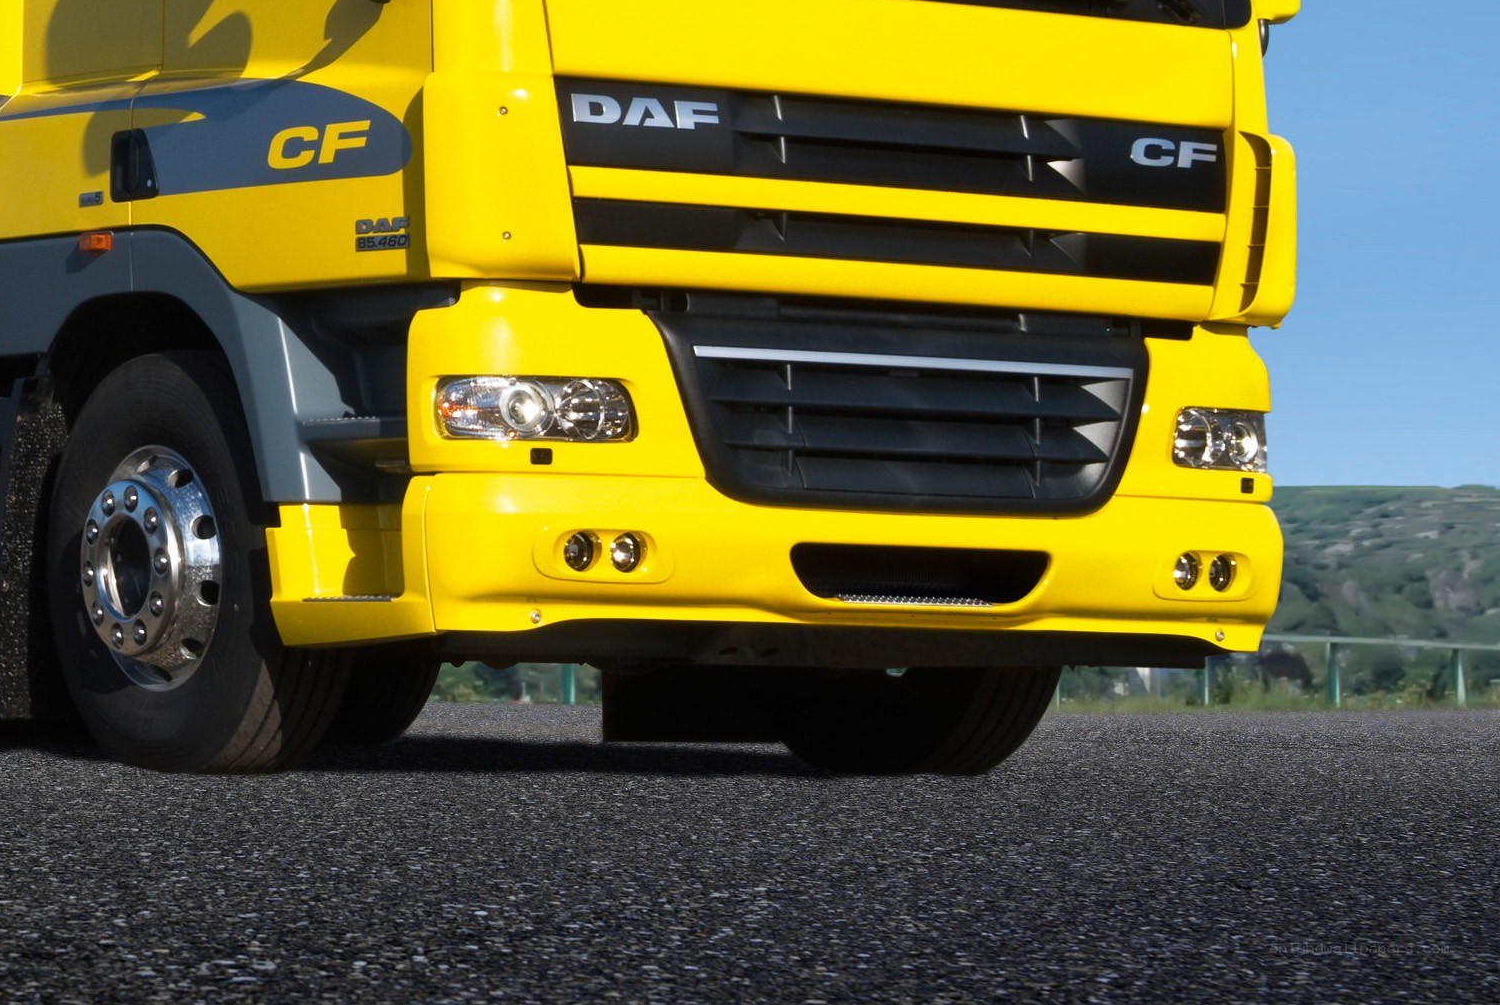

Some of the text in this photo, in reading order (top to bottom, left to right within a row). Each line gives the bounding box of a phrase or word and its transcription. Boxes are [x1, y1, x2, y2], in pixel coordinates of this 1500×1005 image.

[571, 93, 720, 130] DAF
[267, 120, 371, 170] CF
[1130, 137, 1217, 169] CF
[356, 216, 410, 234] DAF
[357, 234, 408, 250] 85.460
